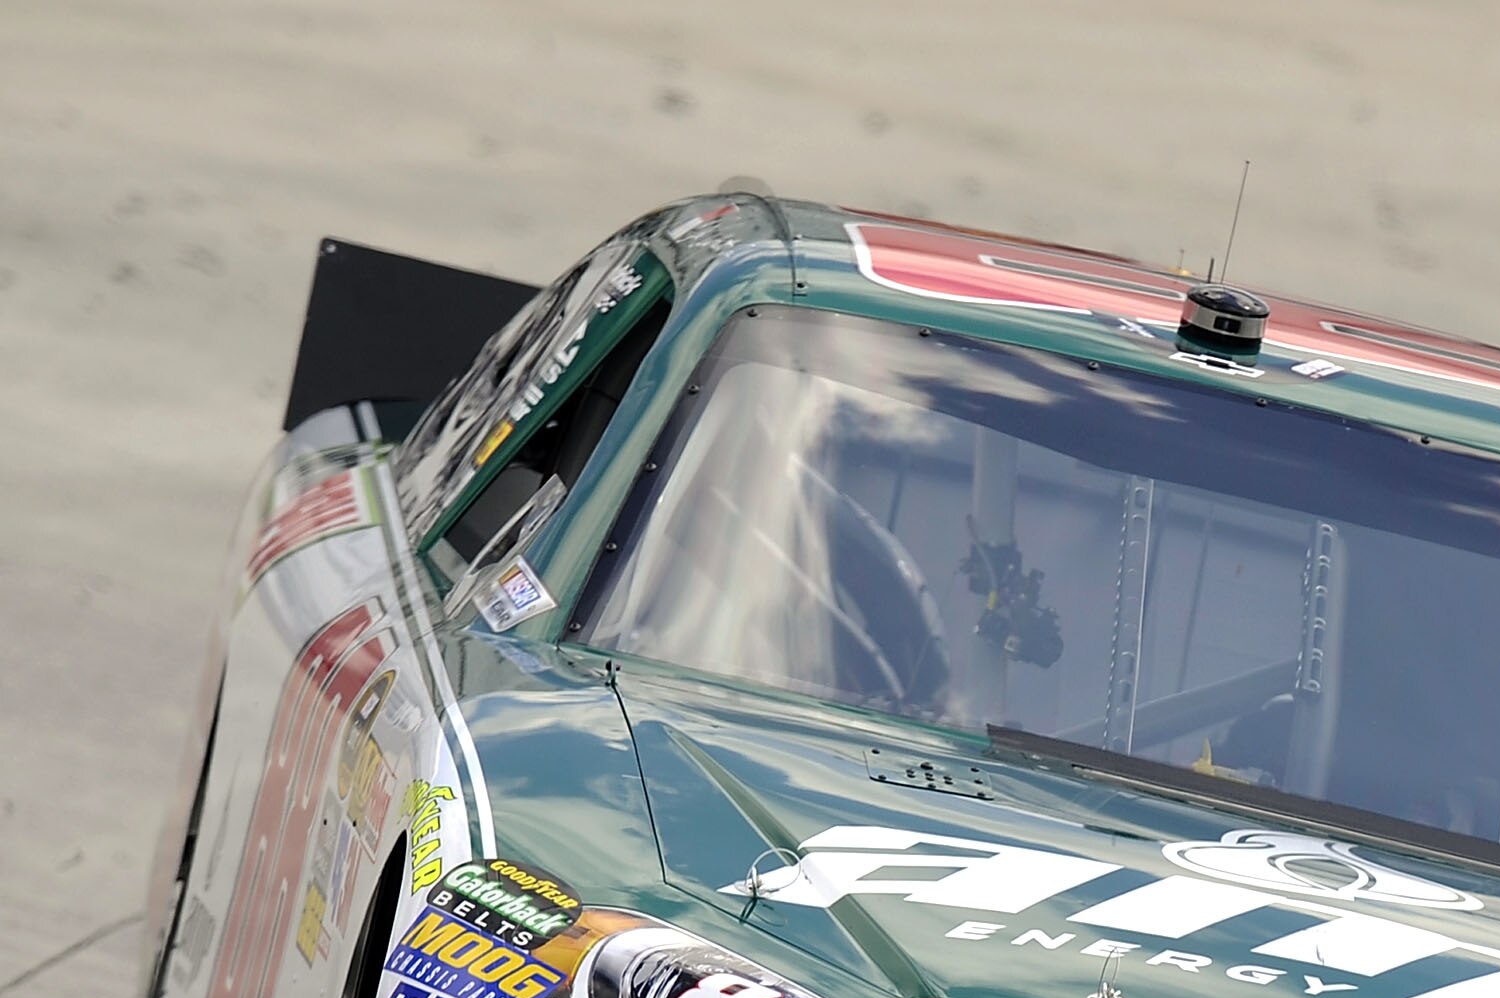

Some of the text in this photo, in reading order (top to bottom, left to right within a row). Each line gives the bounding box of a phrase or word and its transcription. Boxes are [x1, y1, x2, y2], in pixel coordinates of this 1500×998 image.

[446, 864, 562, 937] Gatorback
[490, 860, 578, 910] GOODYEAR
[432, 890, 534, 947] BELTS
[390, 951, 457, 991] CHASSIS
[945, 921, 1358, 996] ENERGY
